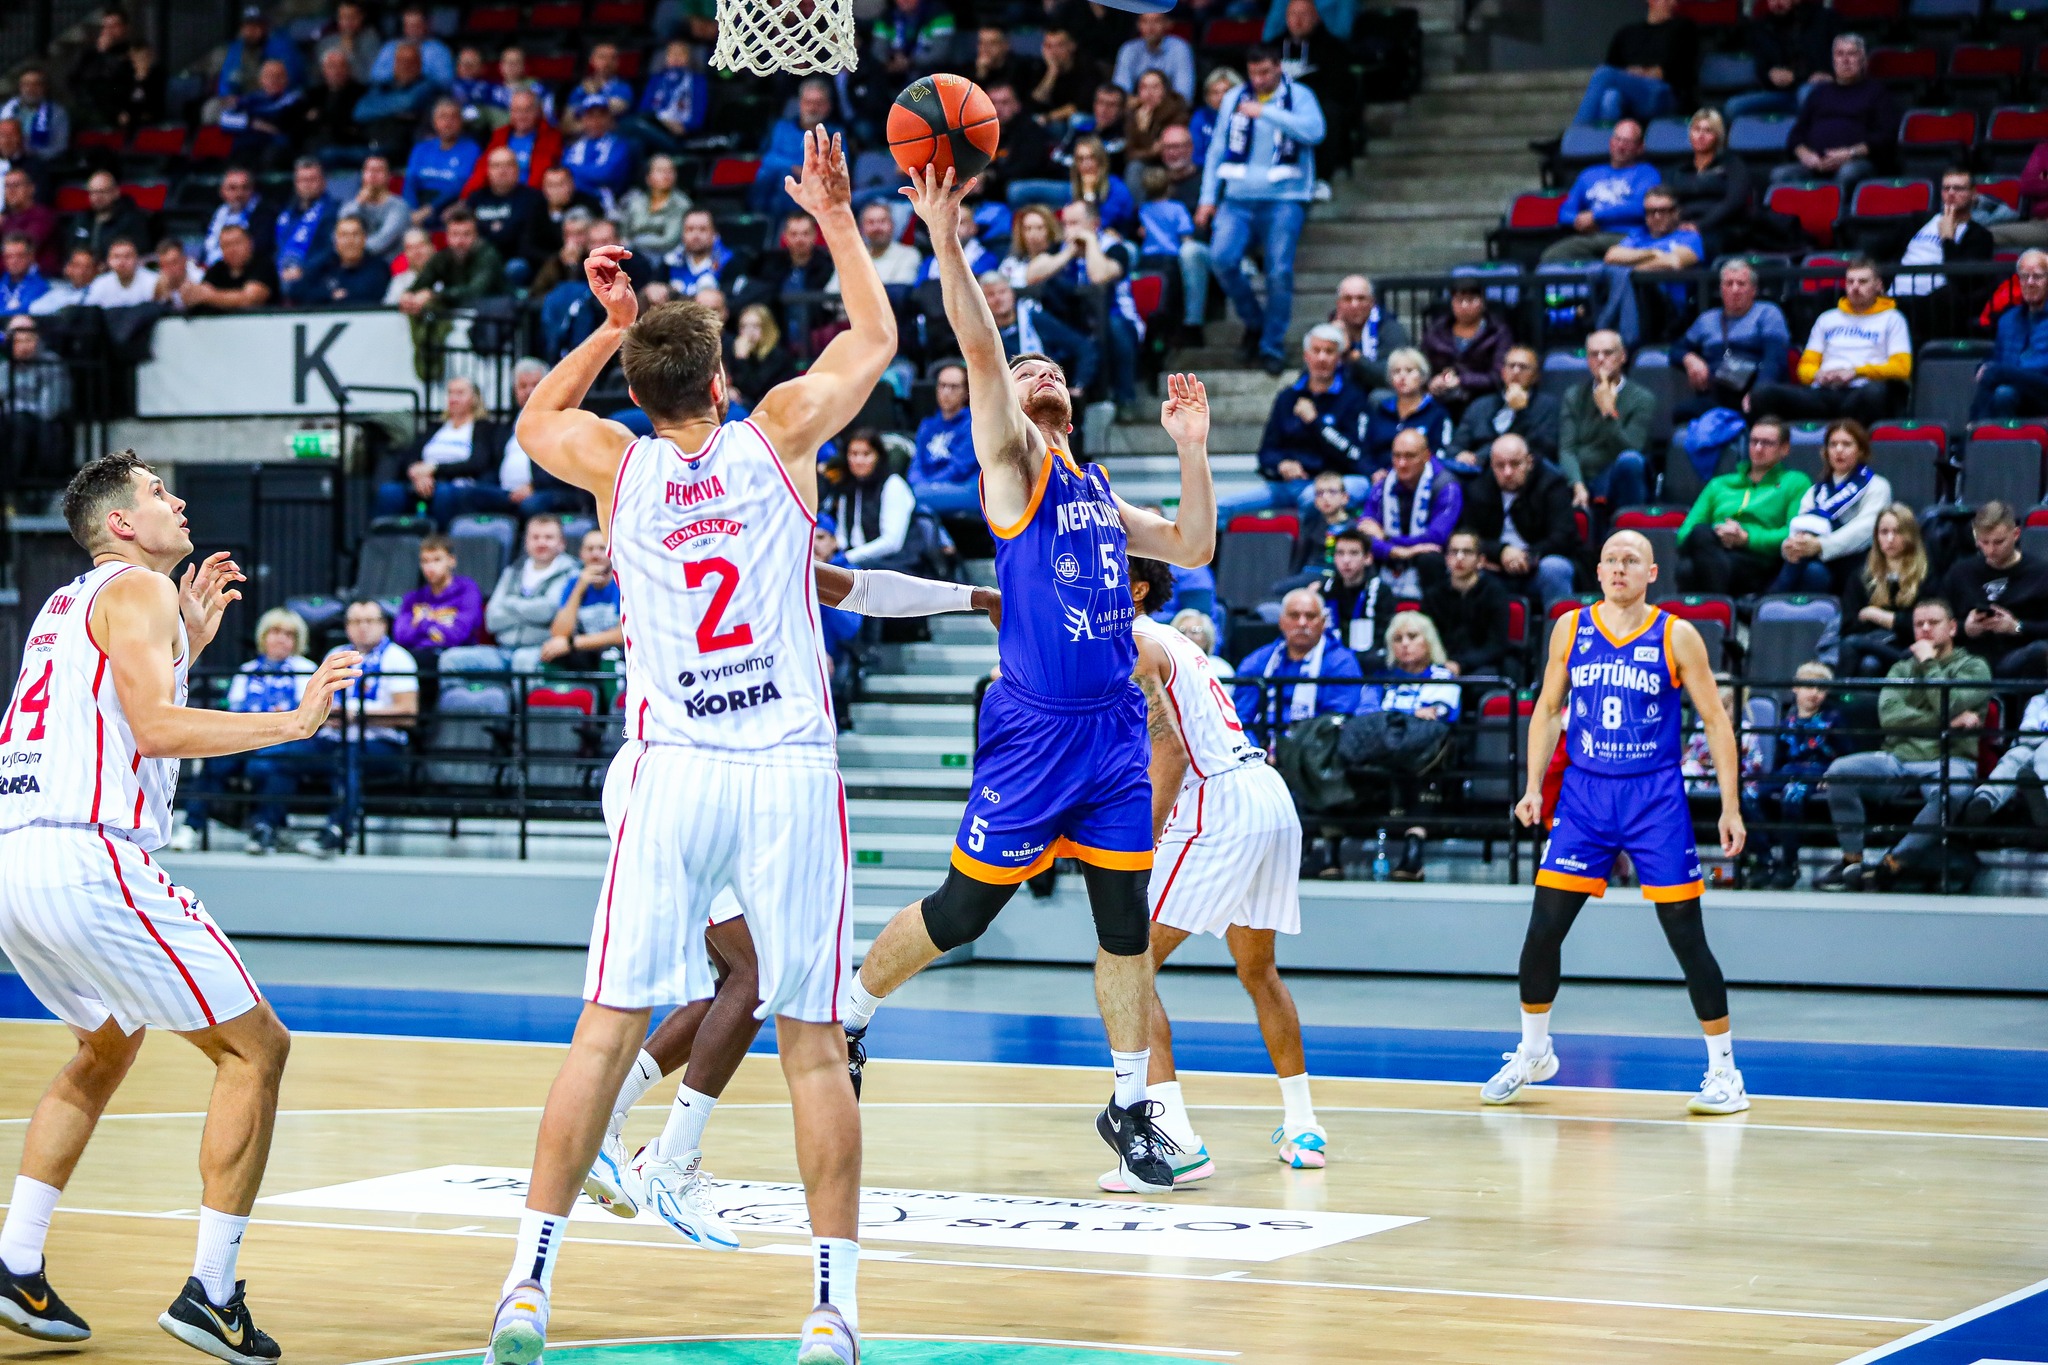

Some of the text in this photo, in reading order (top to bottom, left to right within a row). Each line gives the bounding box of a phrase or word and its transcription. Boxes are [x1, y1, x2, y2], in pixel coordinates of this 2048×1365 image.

[294, 322, 350, 405] K
[665, 475, 725, 506] PENAVA
[1099, 543, 1119, 590] 5
[683, 556, 754, 655] 2
[1571, 658, 1661, 696] NEPTŪNAS
[0, 659, 54, 745] 14
[683, 681, 782, 718] NORFA
[1601, 695, 1622, 731] 8
[0, 774, 41, 795] ORFA
[968, 814, 989, 853] 5
[946, 1217, 1314, 1232] SOTUS
